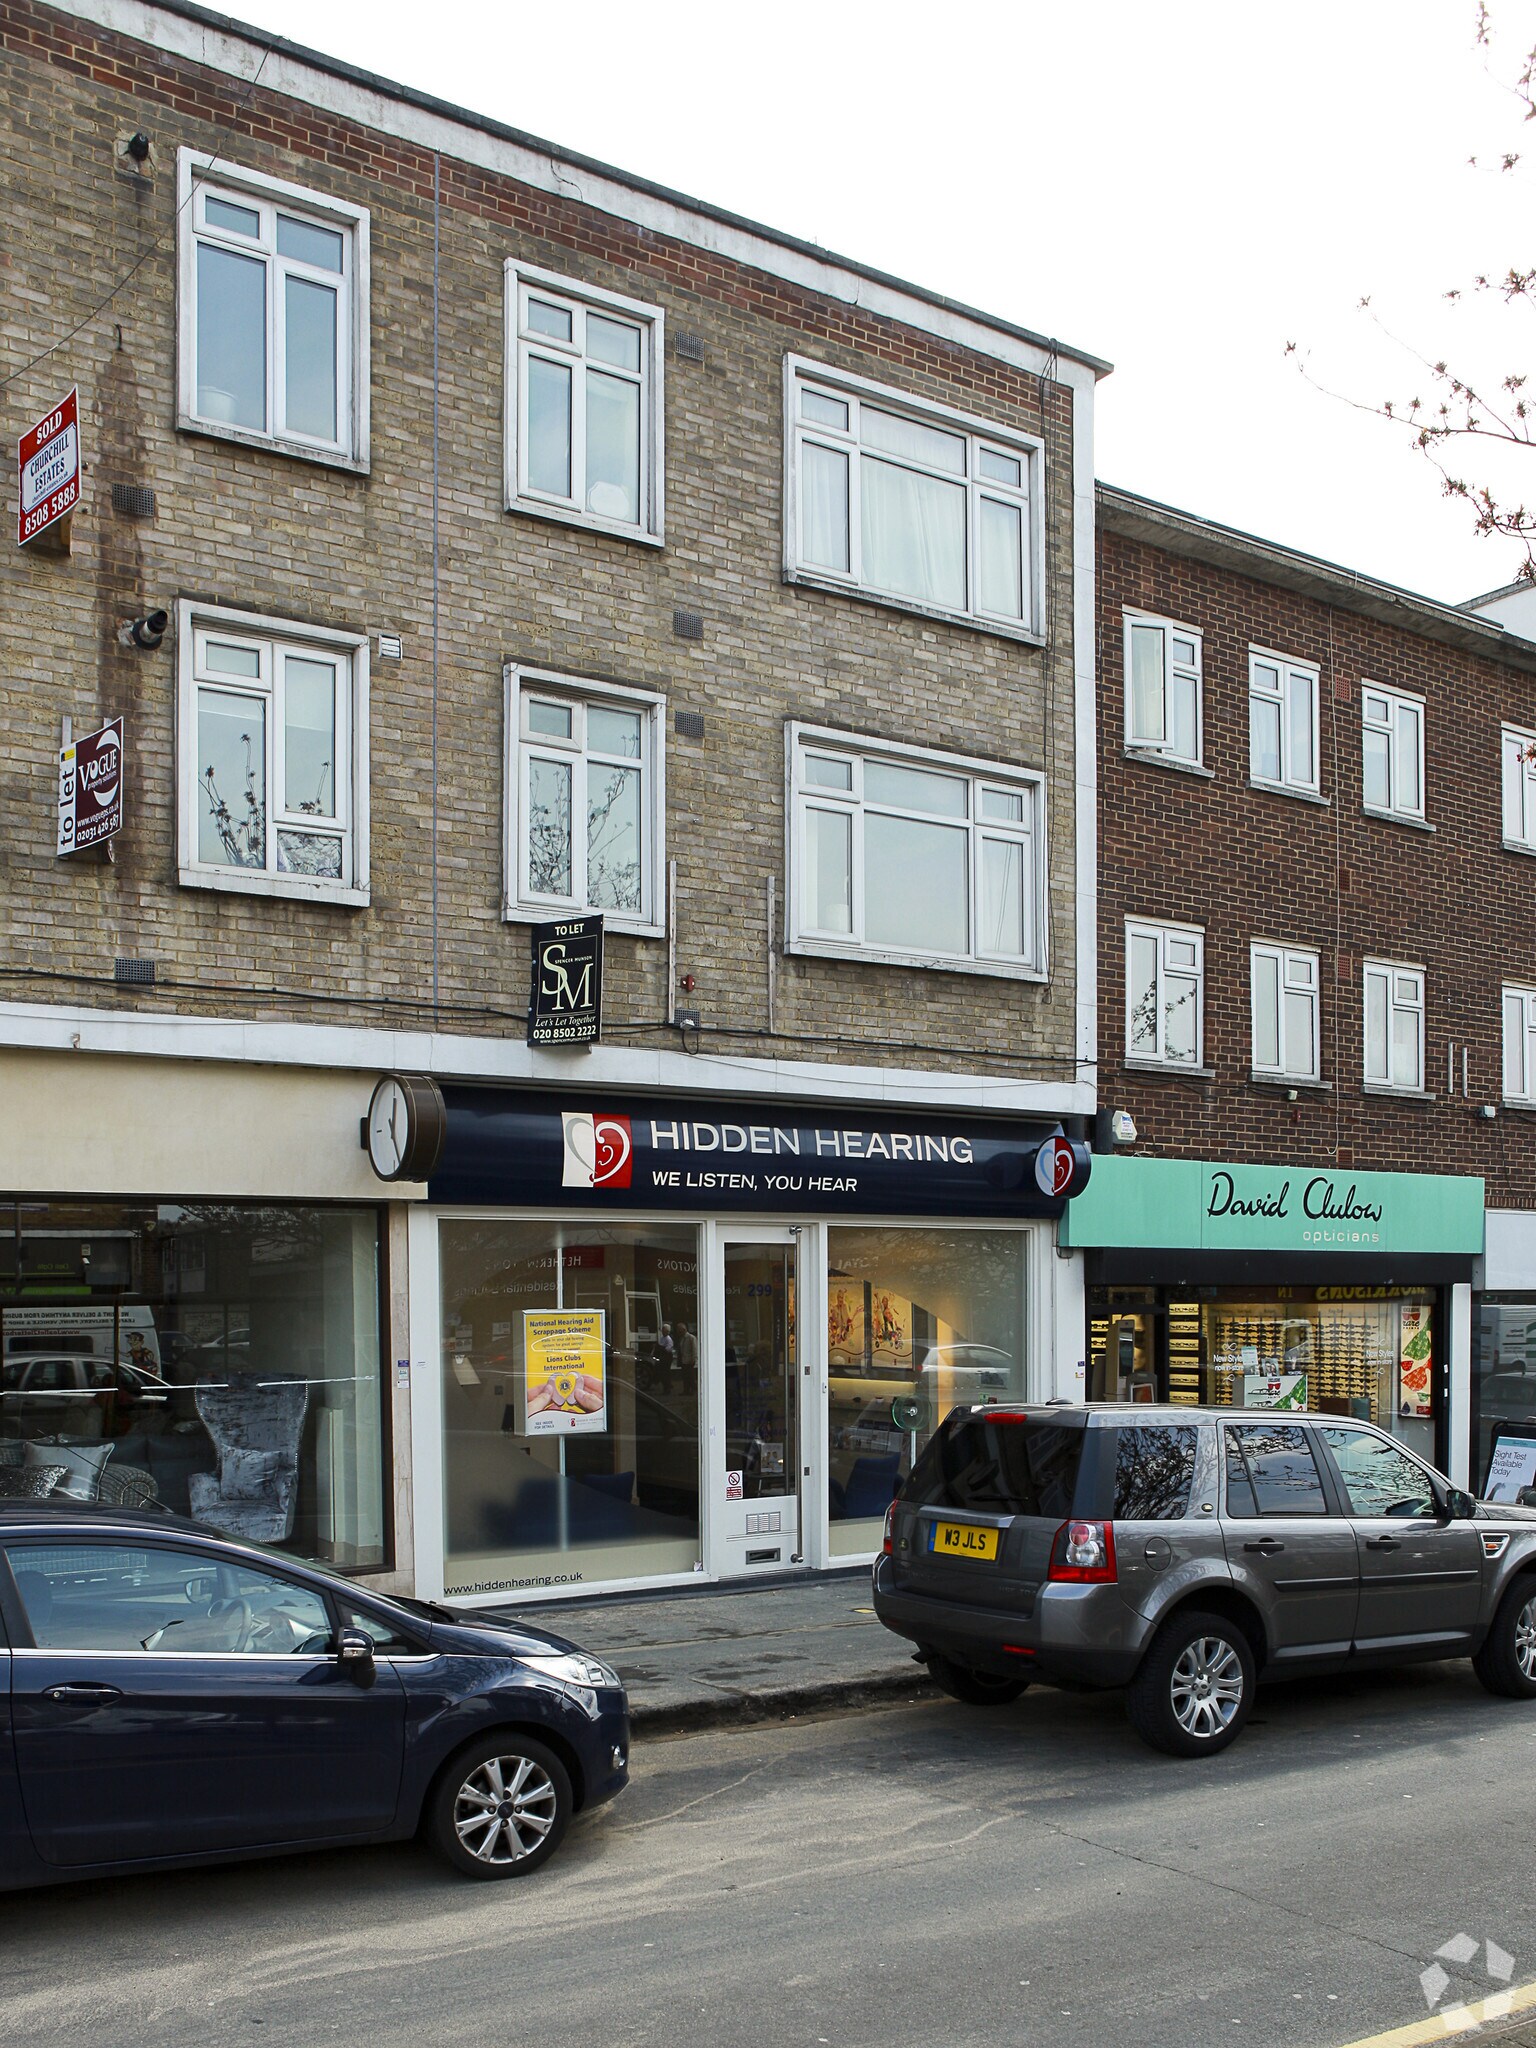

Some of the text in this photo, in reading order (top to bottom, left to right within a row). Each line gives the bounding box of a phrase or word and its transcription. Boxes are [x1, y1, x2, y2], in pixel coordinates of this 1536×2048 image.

[36, 411, 62, 445] SOLD
[30, 432, 69, 477] CHURCHILL
[35, 457, 65, 493] ESTATES
[25, 482, 75, 534] 8508 5888
[78, 749, 117, 792] VOGUE
[87, 770, 117, 791] property solutions
[60, 768, 74, 846] to let
[77, 826, 96, 842] 02031
[97, 820, 108, 838] 426
[555, 923, 584, 936] TO LET
[535, 1015, 596, 1027] Let's Let Together
[533, 1025, 596, 1039] 020 8502 2222
[650, 1120, 974, 1164] HIDDEN HEARING
[652, 1171, 857, 1192] WE LISTEN, YOU HEAR
[1207, 1171, 1382, 1223] David Clulow
[1303, 1230, 1380, 1244] opticians
[747, 1284, 772, 1297] 299
[1213, 1354, 1243, 1366] New Style
[1379, 1350, 1394, 1359] Styles
[544, 1363, 585, 1371] International
[1493, 1459, 1522, 1468] Available
[1495, 1450, 1527, 1461] Sight Test
[1491, 1466, 1511, 1477] Today
[945, 1529, 986, 1550] W3 JLS
[444, 1572, 583, 1594] www.hiddenhearing.co.uk
